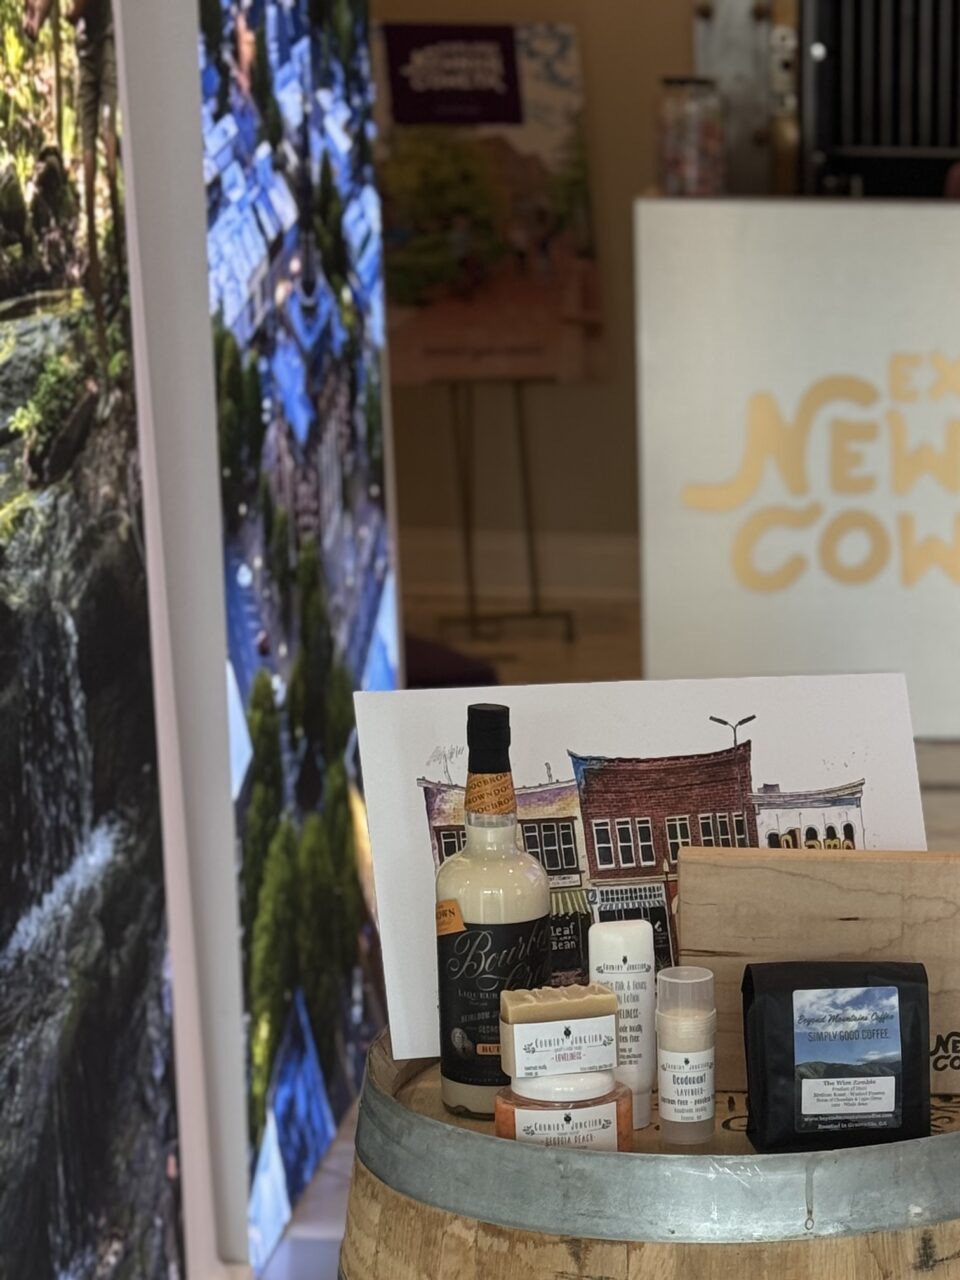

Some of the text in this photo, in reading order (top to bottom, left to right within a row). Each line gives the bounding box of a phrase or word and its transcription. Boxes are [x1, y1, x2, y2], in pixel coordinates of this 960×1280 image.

[550, 922, 576, 937] Leaf
[551, 941, 577, 951] Bean
[798, 1012, 894, 1026] Beyond Mountains Coffee
[808, 1028, 889, 1042] SIMPLY GOOD COFFEE
